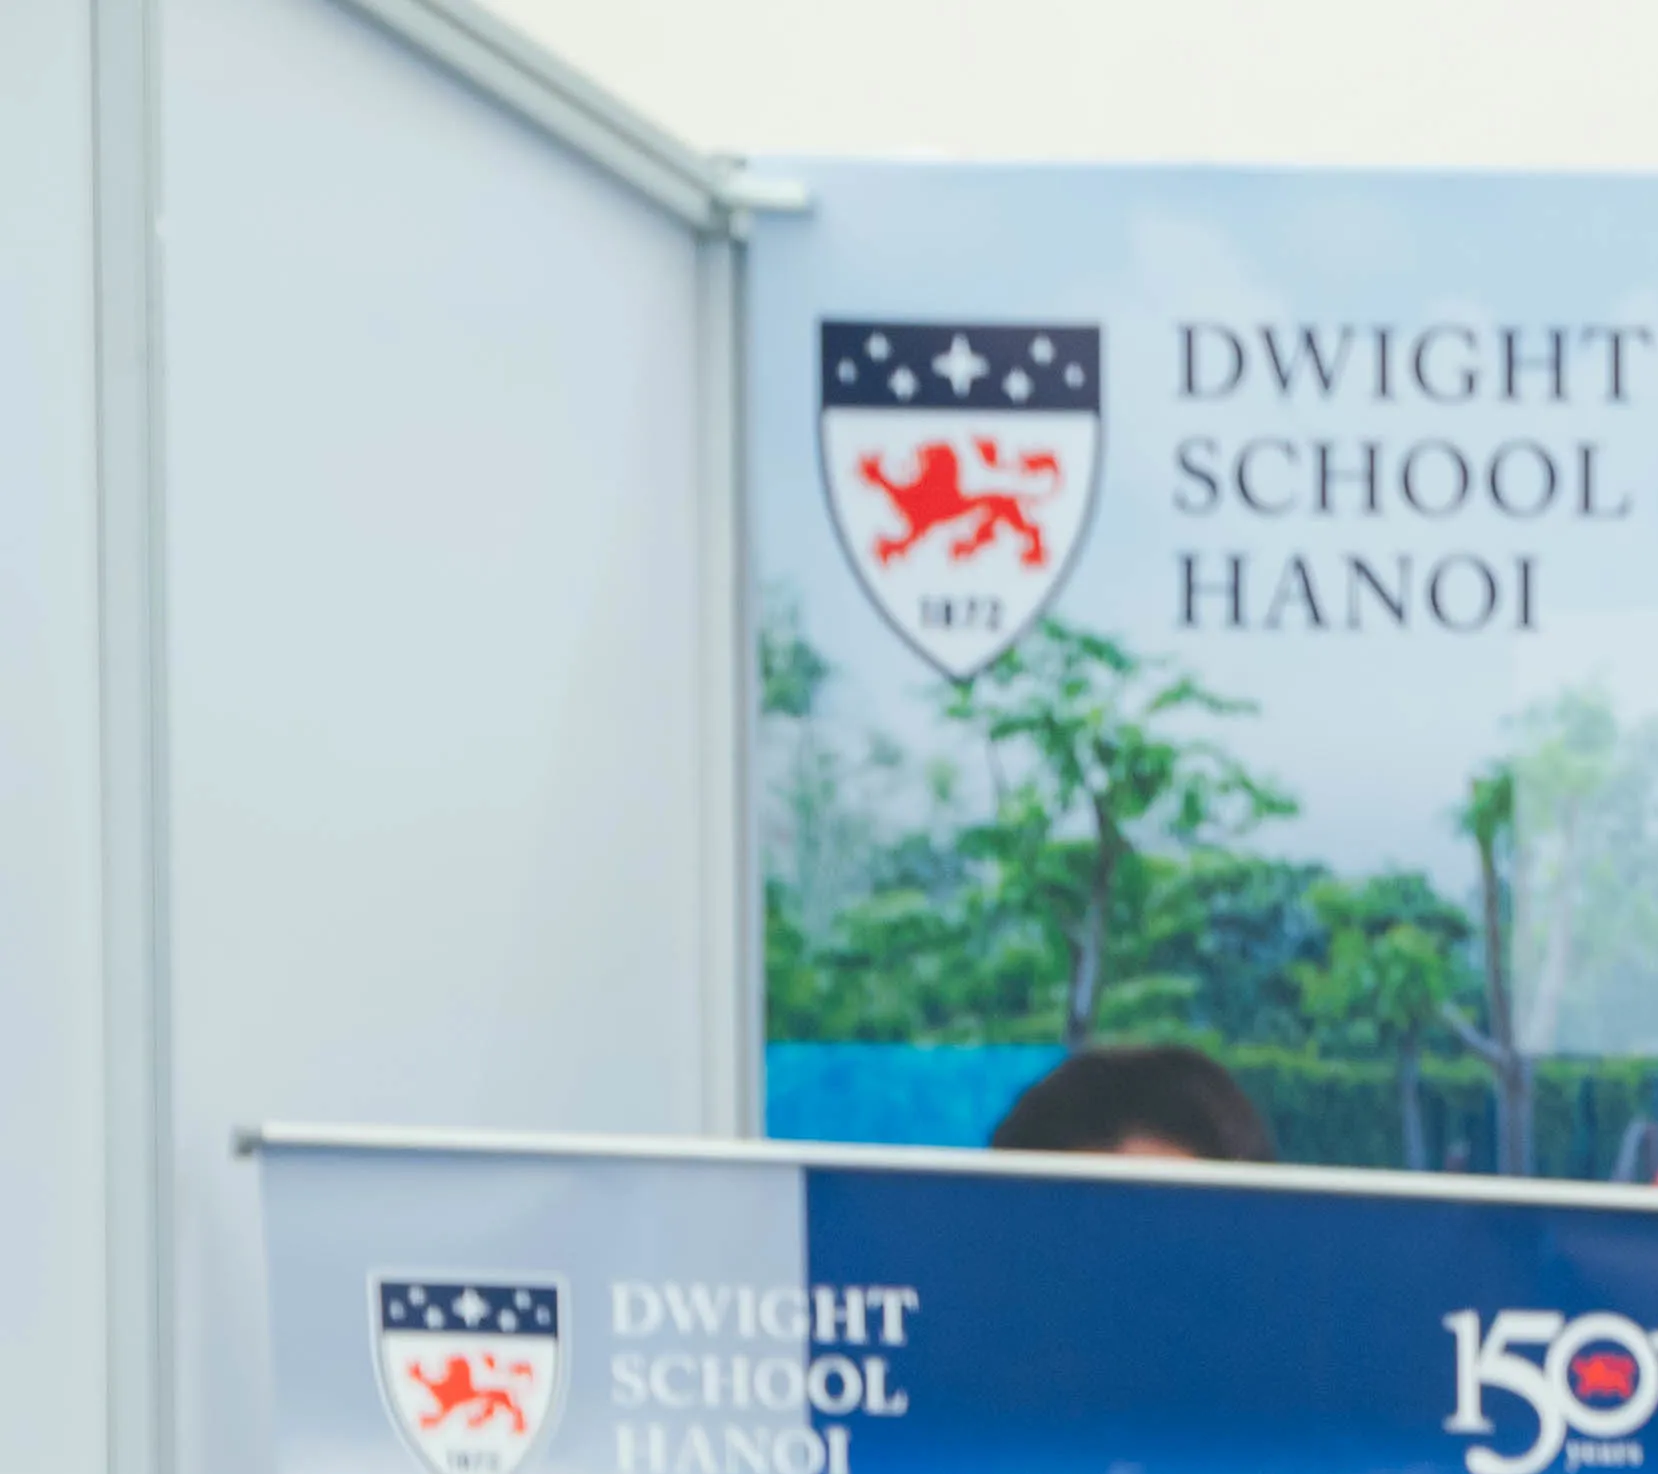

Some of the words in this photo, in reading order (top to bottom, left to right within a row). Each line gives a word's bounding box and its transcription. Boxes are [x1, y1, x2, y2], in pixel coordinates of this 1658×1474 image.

[1174, 321, 1656, 404] DWIGHT
[1171, 436, 1634, 520] SCHOOL
[917, 595, 1003, 633] 1872
[1175, 552, 1541, 633] HANOI
[609, 1279, 920, 1346] DWIGHT
[610, 1352, 910, 1417] SCHOOL
